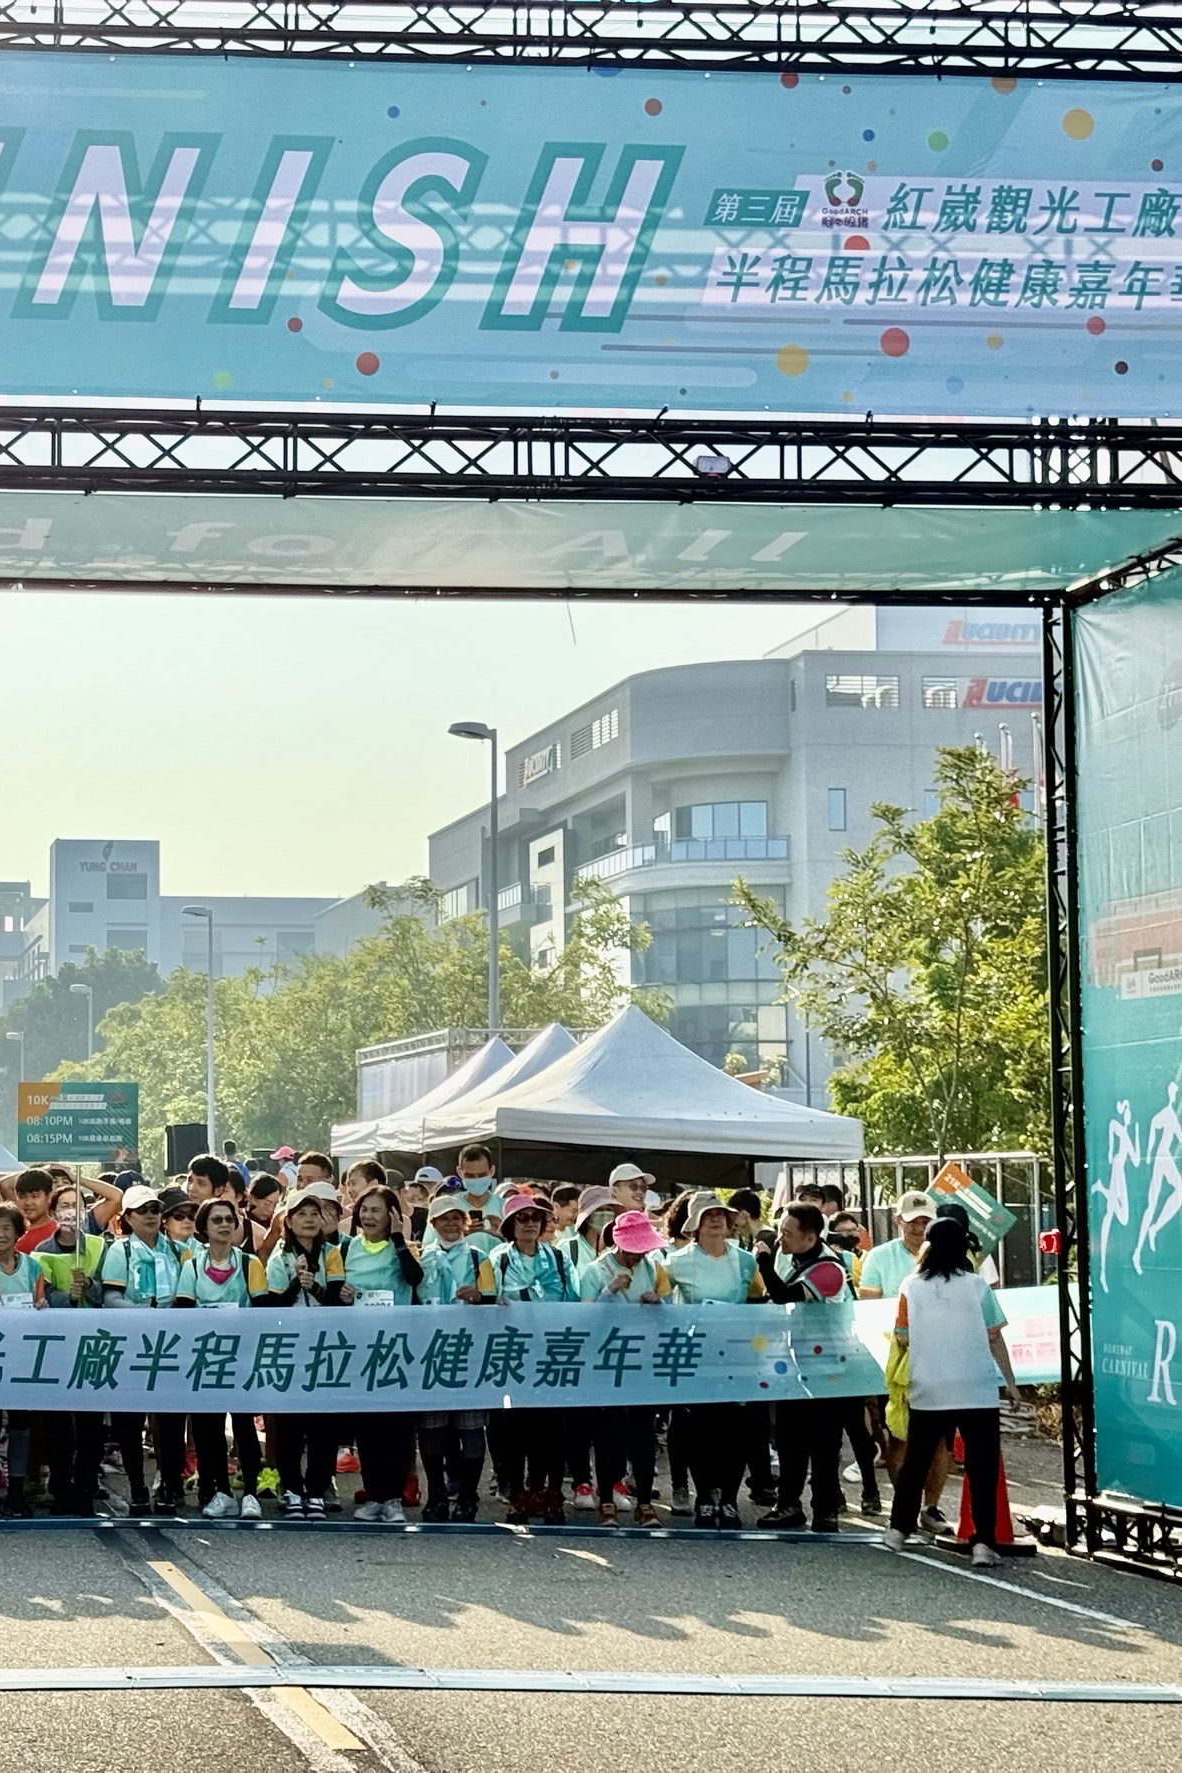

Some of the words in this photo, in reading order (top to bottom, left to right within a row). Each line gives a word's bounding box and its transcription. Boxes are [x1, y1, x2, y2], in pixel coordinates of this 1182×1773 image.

[711, 192, 802, 225] 第三屆
[821, 207, 869, 215] GoodARCH
[716, 251, 1182, 311] 半程馬拉松健康嘉年
[530, 528, 808, 563] All
[79, 861, 107, 873] YUNG
[110, 861, 138, 873] CHAN
[26, 1095, 49, 1106] 10K
[26, 1116, 73, 1126] 08:10PM
[26, 1133, 73, 1143] 08:15PM
[1102, 1357, 1149, 1380] CARNIVAL
